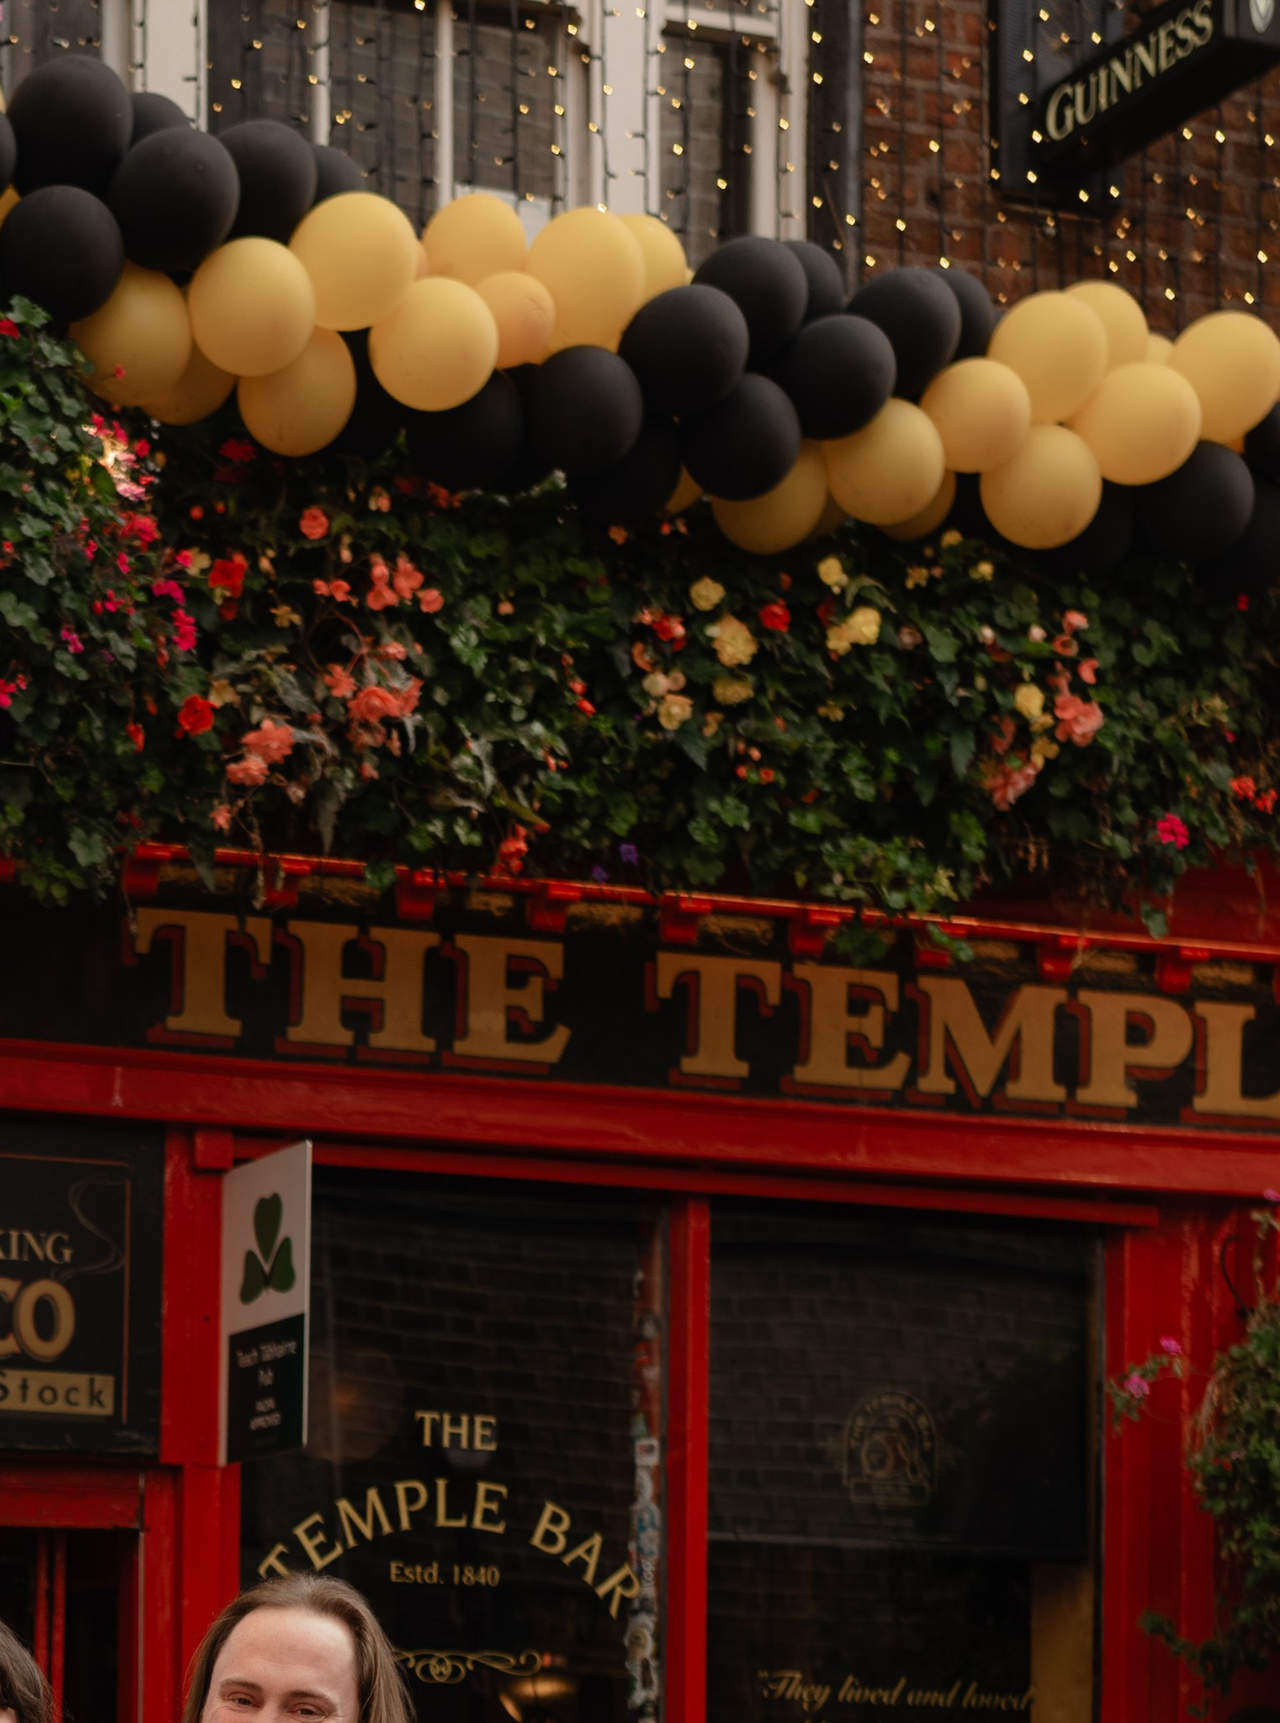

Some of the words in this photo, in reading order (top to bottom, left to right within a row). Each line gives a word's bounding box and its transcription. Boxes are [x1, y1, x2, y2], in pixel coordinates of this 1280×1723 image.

[1045, 0, 1214, 141] GUINNESS
[128, 906, 572, 1070] THE
[415, 1409, 499, 1452] THE
[389, 1560, 440, 1586] Estd.
[452, 1562, 501, 1588] 1840
[529, 1500, 641, 1621] BAR
[836, 1673, 908, 1708] lived
[906, 1679, 962, 1709] and
